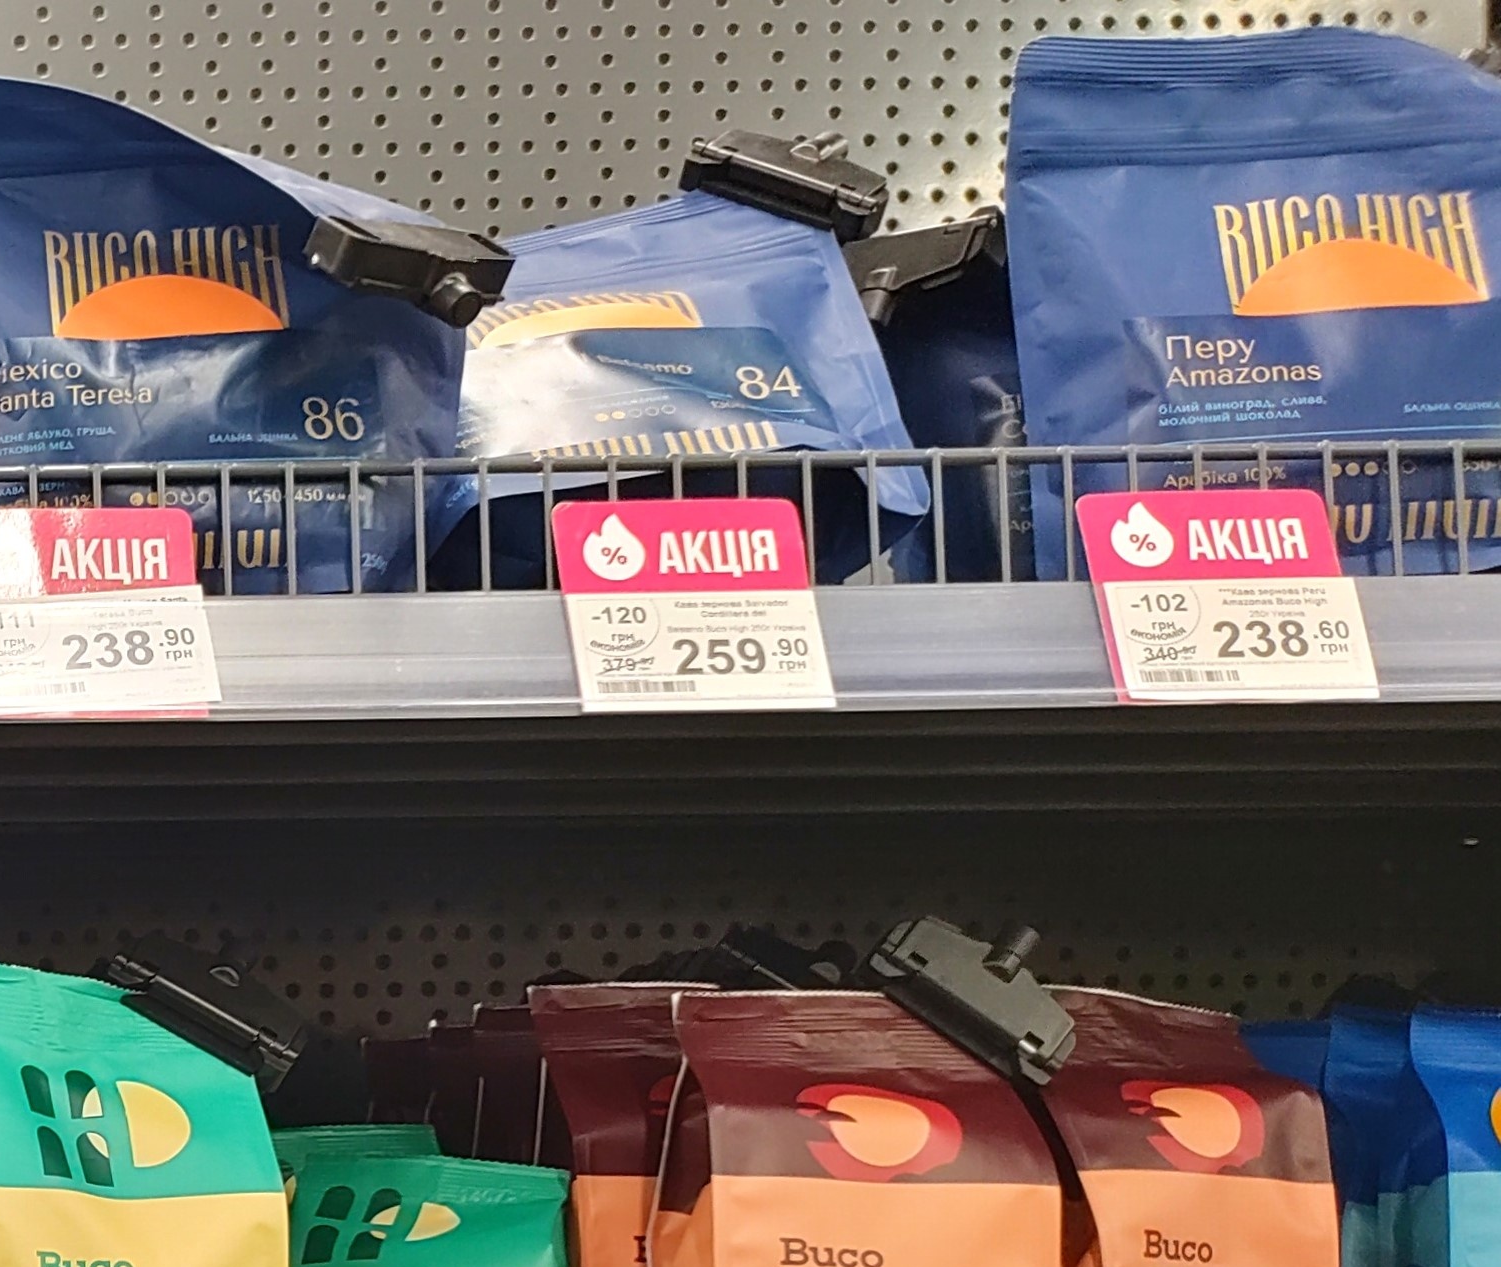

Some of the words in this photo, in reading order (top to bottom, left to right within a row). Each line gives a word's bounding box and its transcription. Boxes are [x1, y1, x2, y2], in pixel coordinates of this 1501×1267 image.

[1215, 194, 1346, 314] BUCO
[1357, 191, 1489, 301] HIGH
[1165, 335, 1255, 364] Перу
[735, 365, 801, 399] 84
[1166, 363, 1322, 387] Amazonas
[303, 397, 365, 441] 86
[659, 529, 779, 577] АКЦІЯ
[1188, 518, 1309, 563] АКЦІЯ
[51, 539, 168, 585] АКЦІЯ
[1130, 594, 1188, 614] -102
[62, 630, 154, 670] 238
[673, 639, 766, 675] 259
[1213, 620, 1309, 658] 238
[1143, 1229, 1213, 1263] Buco
